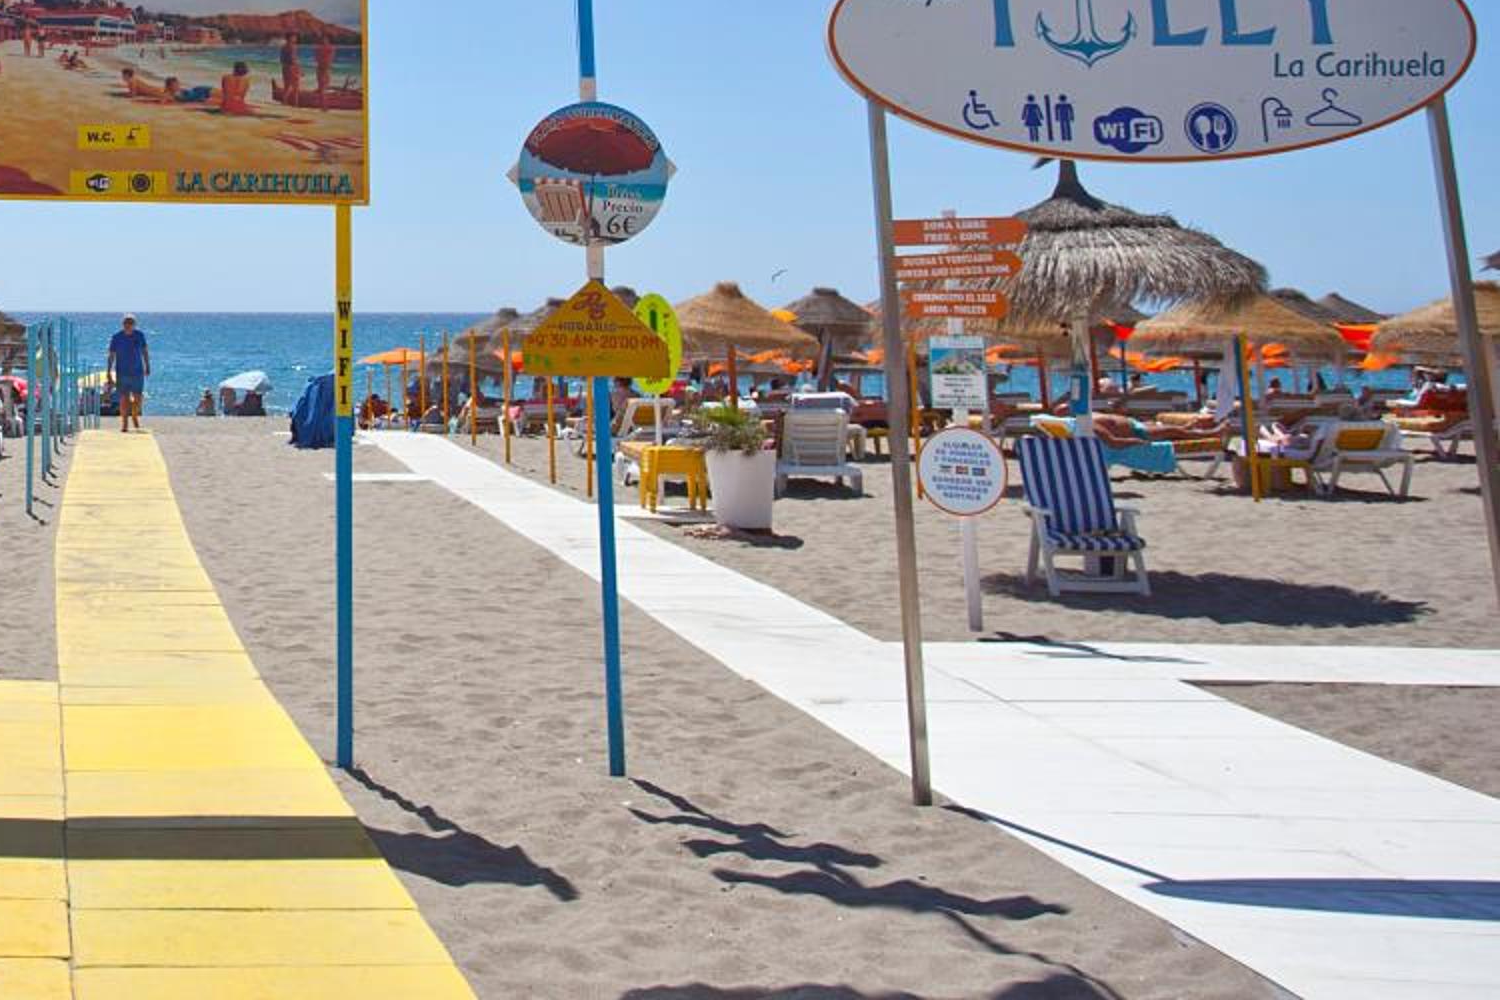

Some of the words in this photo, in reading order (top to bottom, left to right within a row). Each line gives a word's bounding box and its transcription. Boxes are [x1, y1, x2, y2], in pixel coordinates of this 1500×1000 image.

[1274, 53, 1304, 78] La
[1316, 51, 1446, 78] Carihuela
[1099, 120, 1156, 139] WiFi
[175, 171, 207, 193] LA
[209, 172, 354, 194] CARIHUELA
[603, 201, 643, 213] Precio
[606, 213, 638, 235] 6€
[337, 300, 351, 405] WIFI
